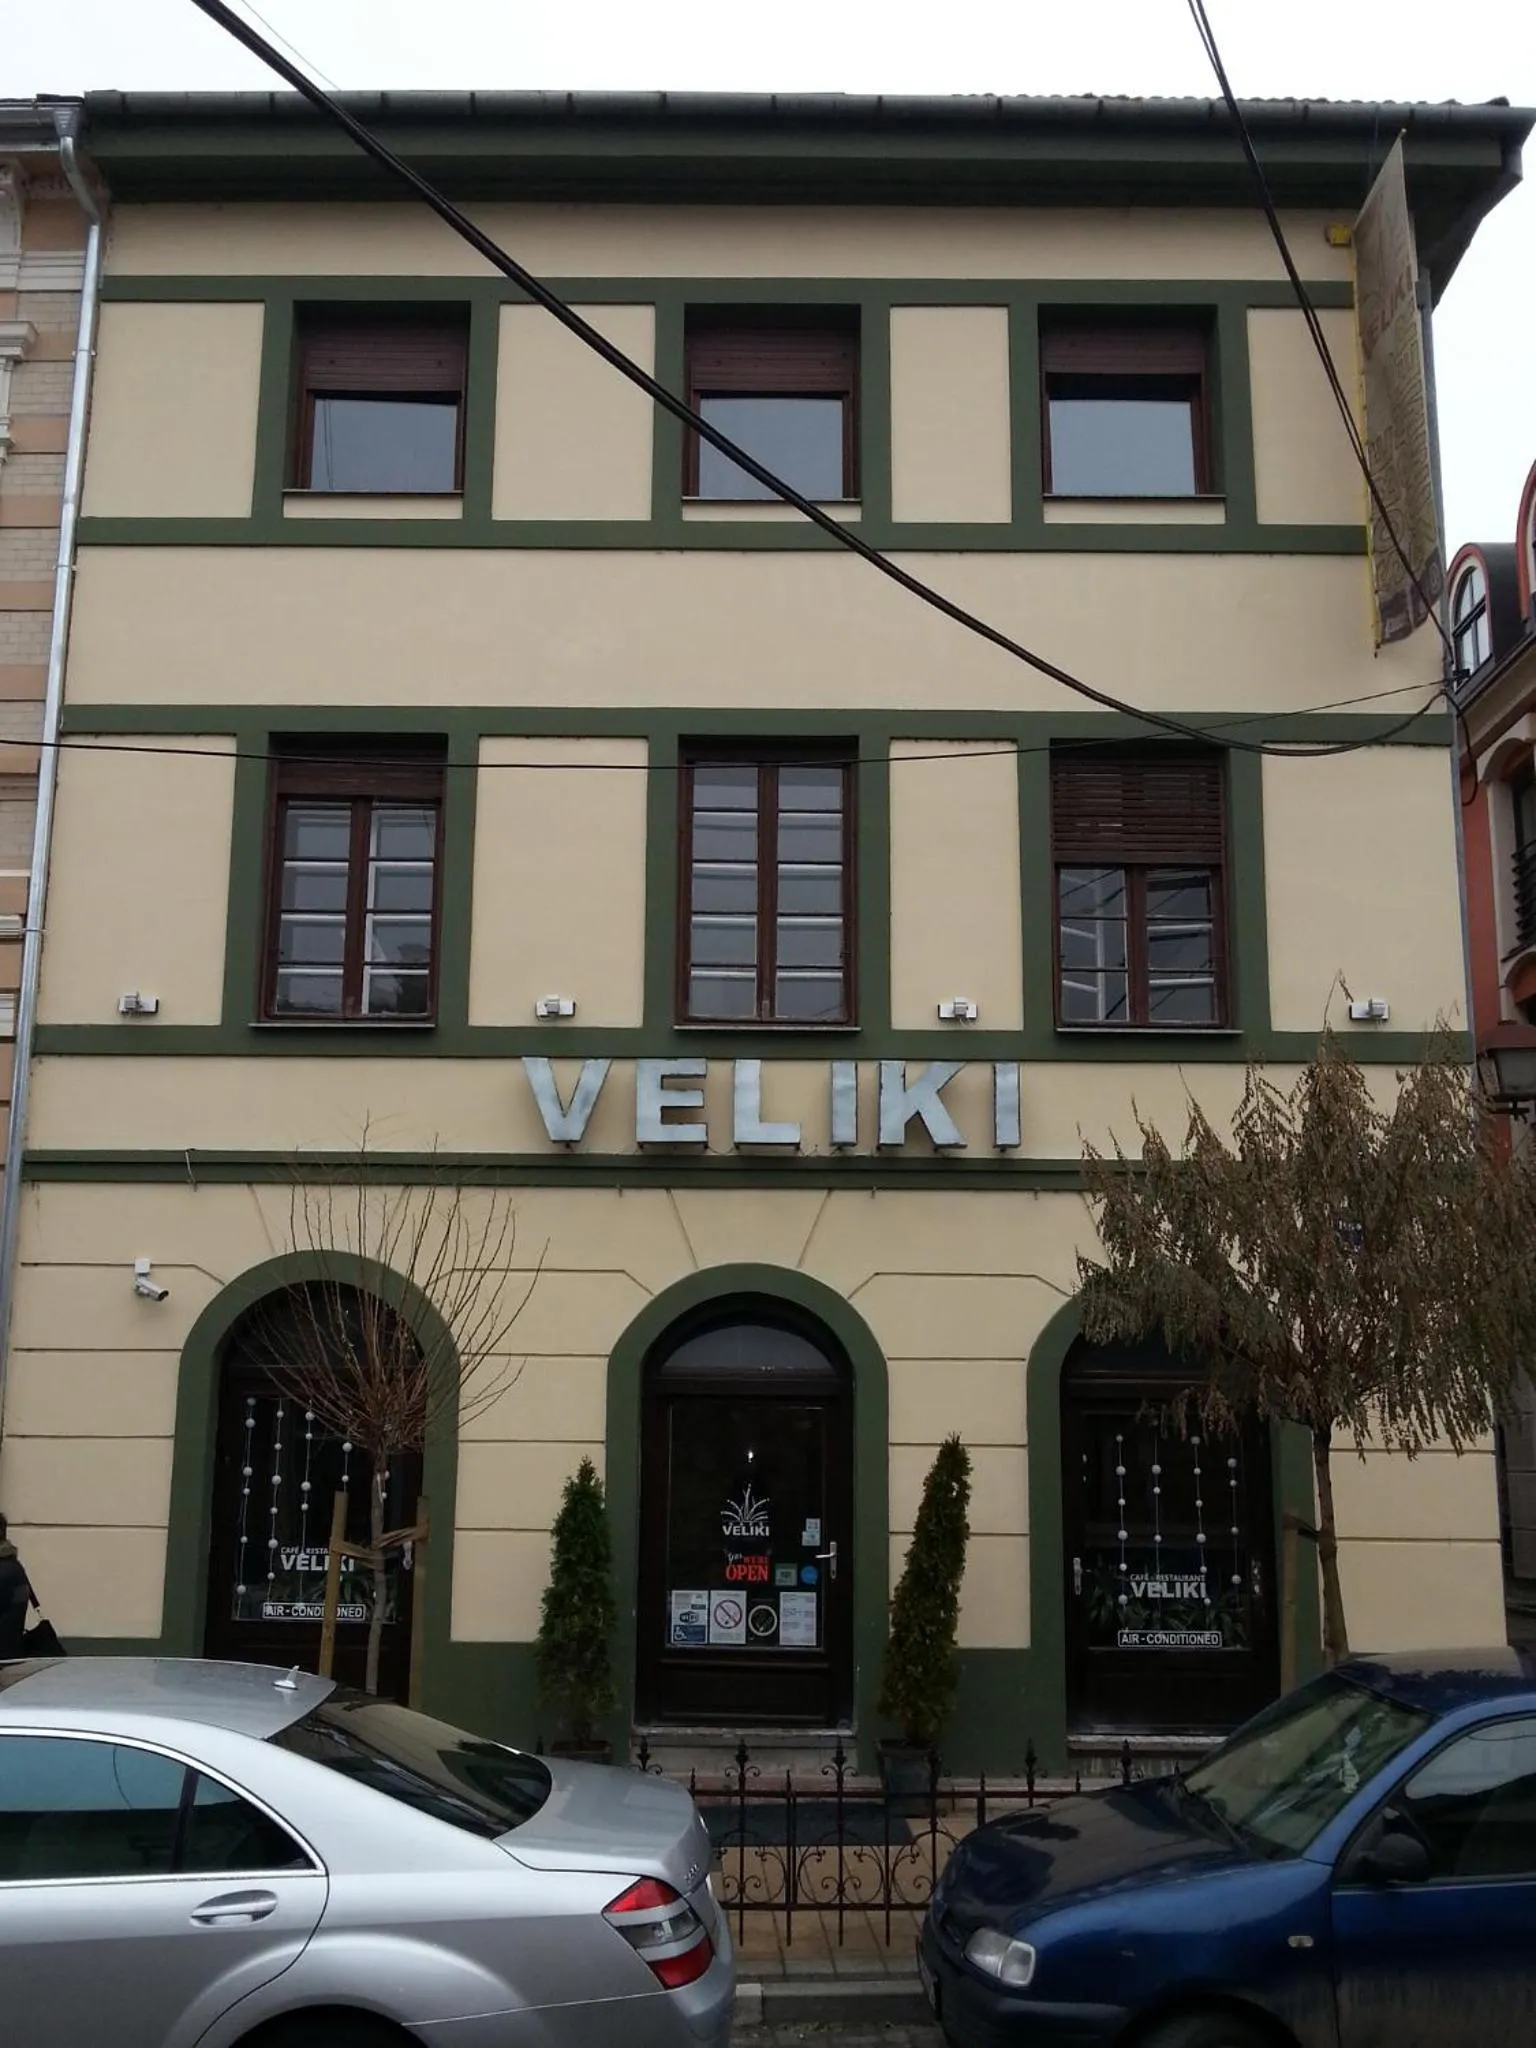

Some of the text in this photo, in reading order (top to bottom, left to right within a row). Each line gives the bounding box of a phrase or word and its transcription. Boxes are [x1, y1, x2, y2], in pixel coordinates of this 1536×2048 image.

[1361, 264, 1413, 360] VELIKI
[521, 1057, 1021, 1149] VELIKI
[722, 1525, 770, 1537] VELIKI
[726, 1564, 768, 1581] OPEN
[1131, 1582, 1206, 1598] VELIKI
